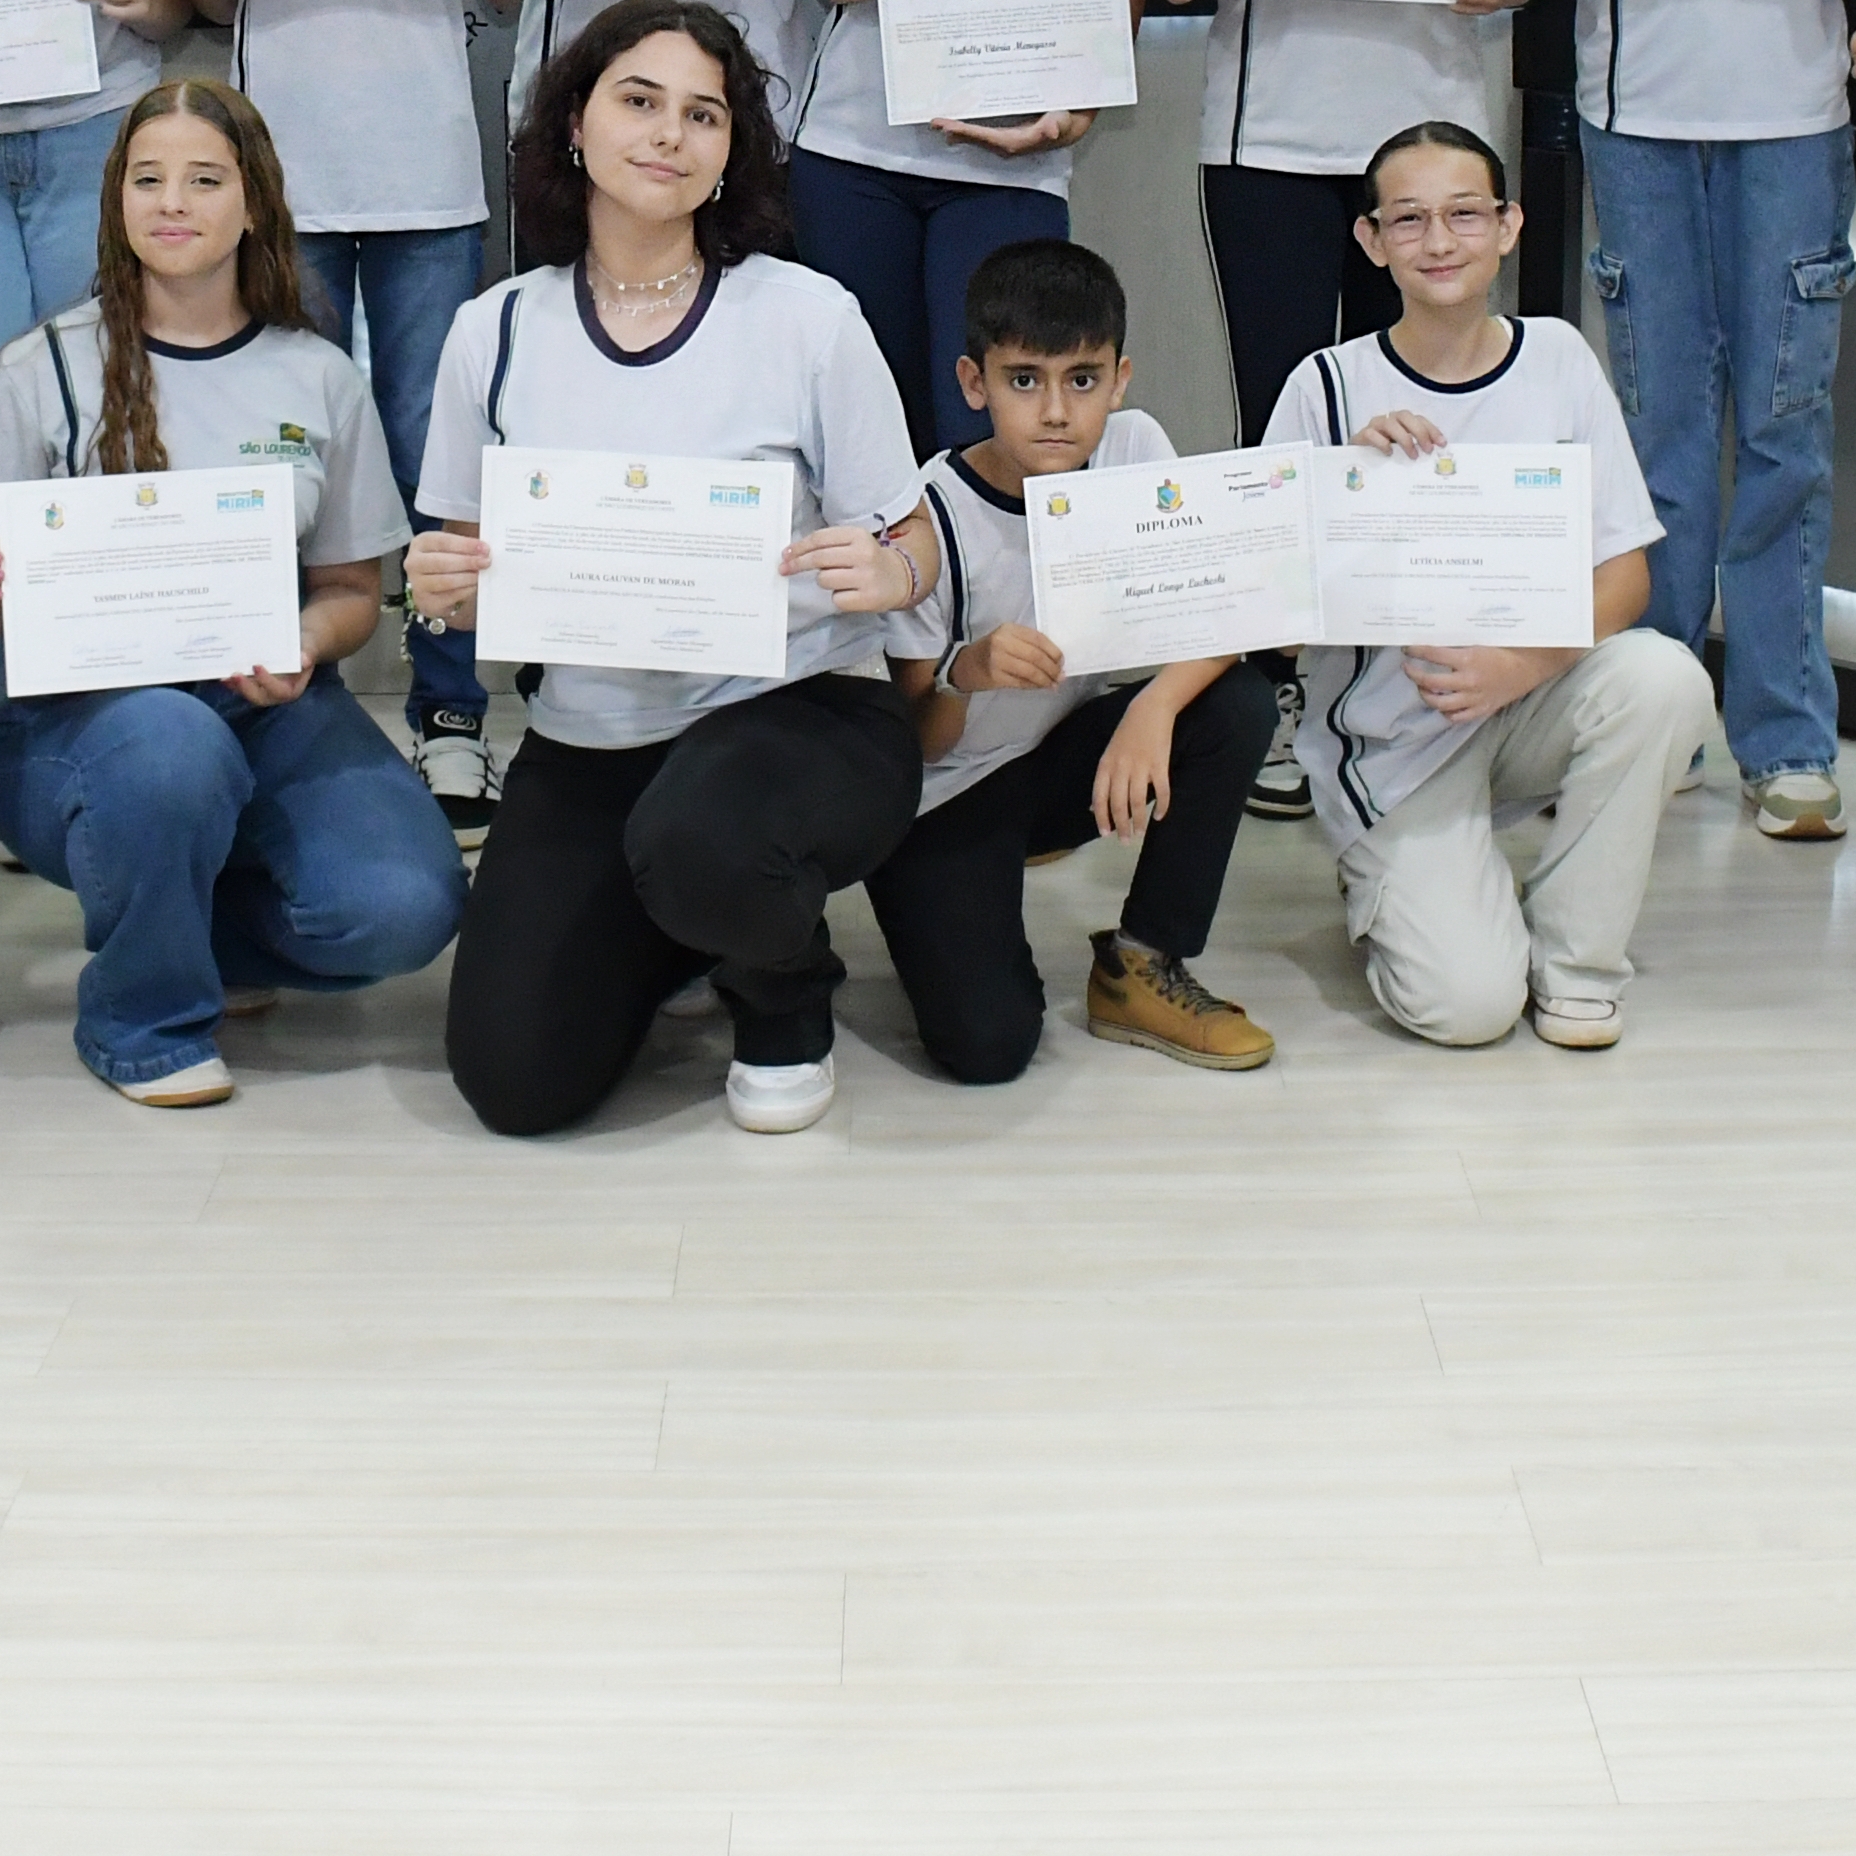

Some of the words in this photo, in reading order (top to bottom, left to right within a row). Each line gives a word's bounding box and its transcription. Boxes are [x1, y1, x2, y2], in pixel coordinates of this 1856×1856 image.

[1135, 515, 1204, 534] DIPLOMA
[569, 571, 601, 582] LAURA
[658, 577, 696, 587] MORAIS
